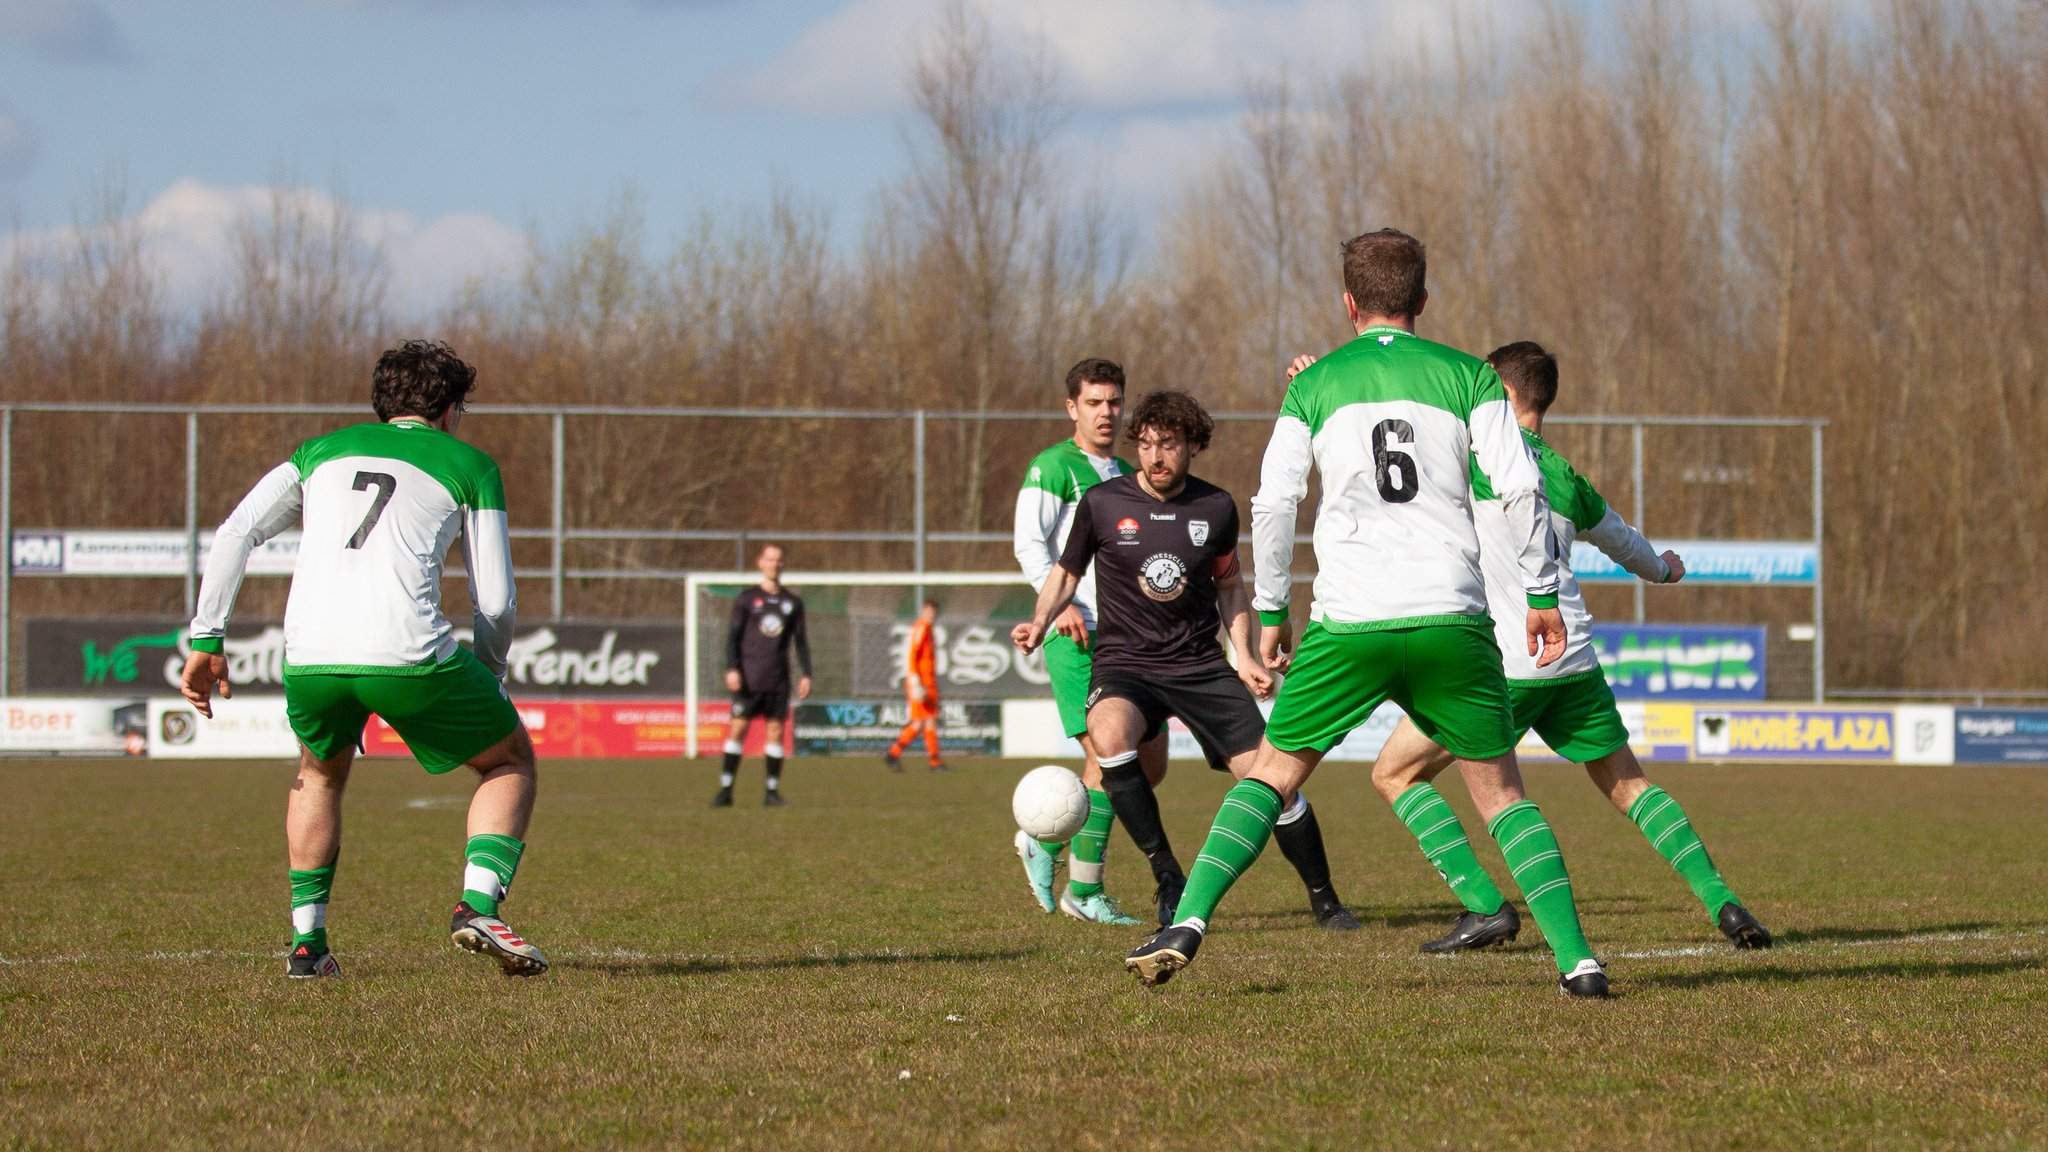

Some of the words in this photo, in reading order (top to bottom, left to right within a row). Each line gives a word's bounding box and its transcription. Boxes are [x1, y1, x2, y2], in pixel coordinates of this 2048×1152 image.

[1372, 419, 1419, 503] 6
[345, 471, 397, 549] 7
[8, 707, 75, 731] Boer
[825, 704, 876, 726] VDS
